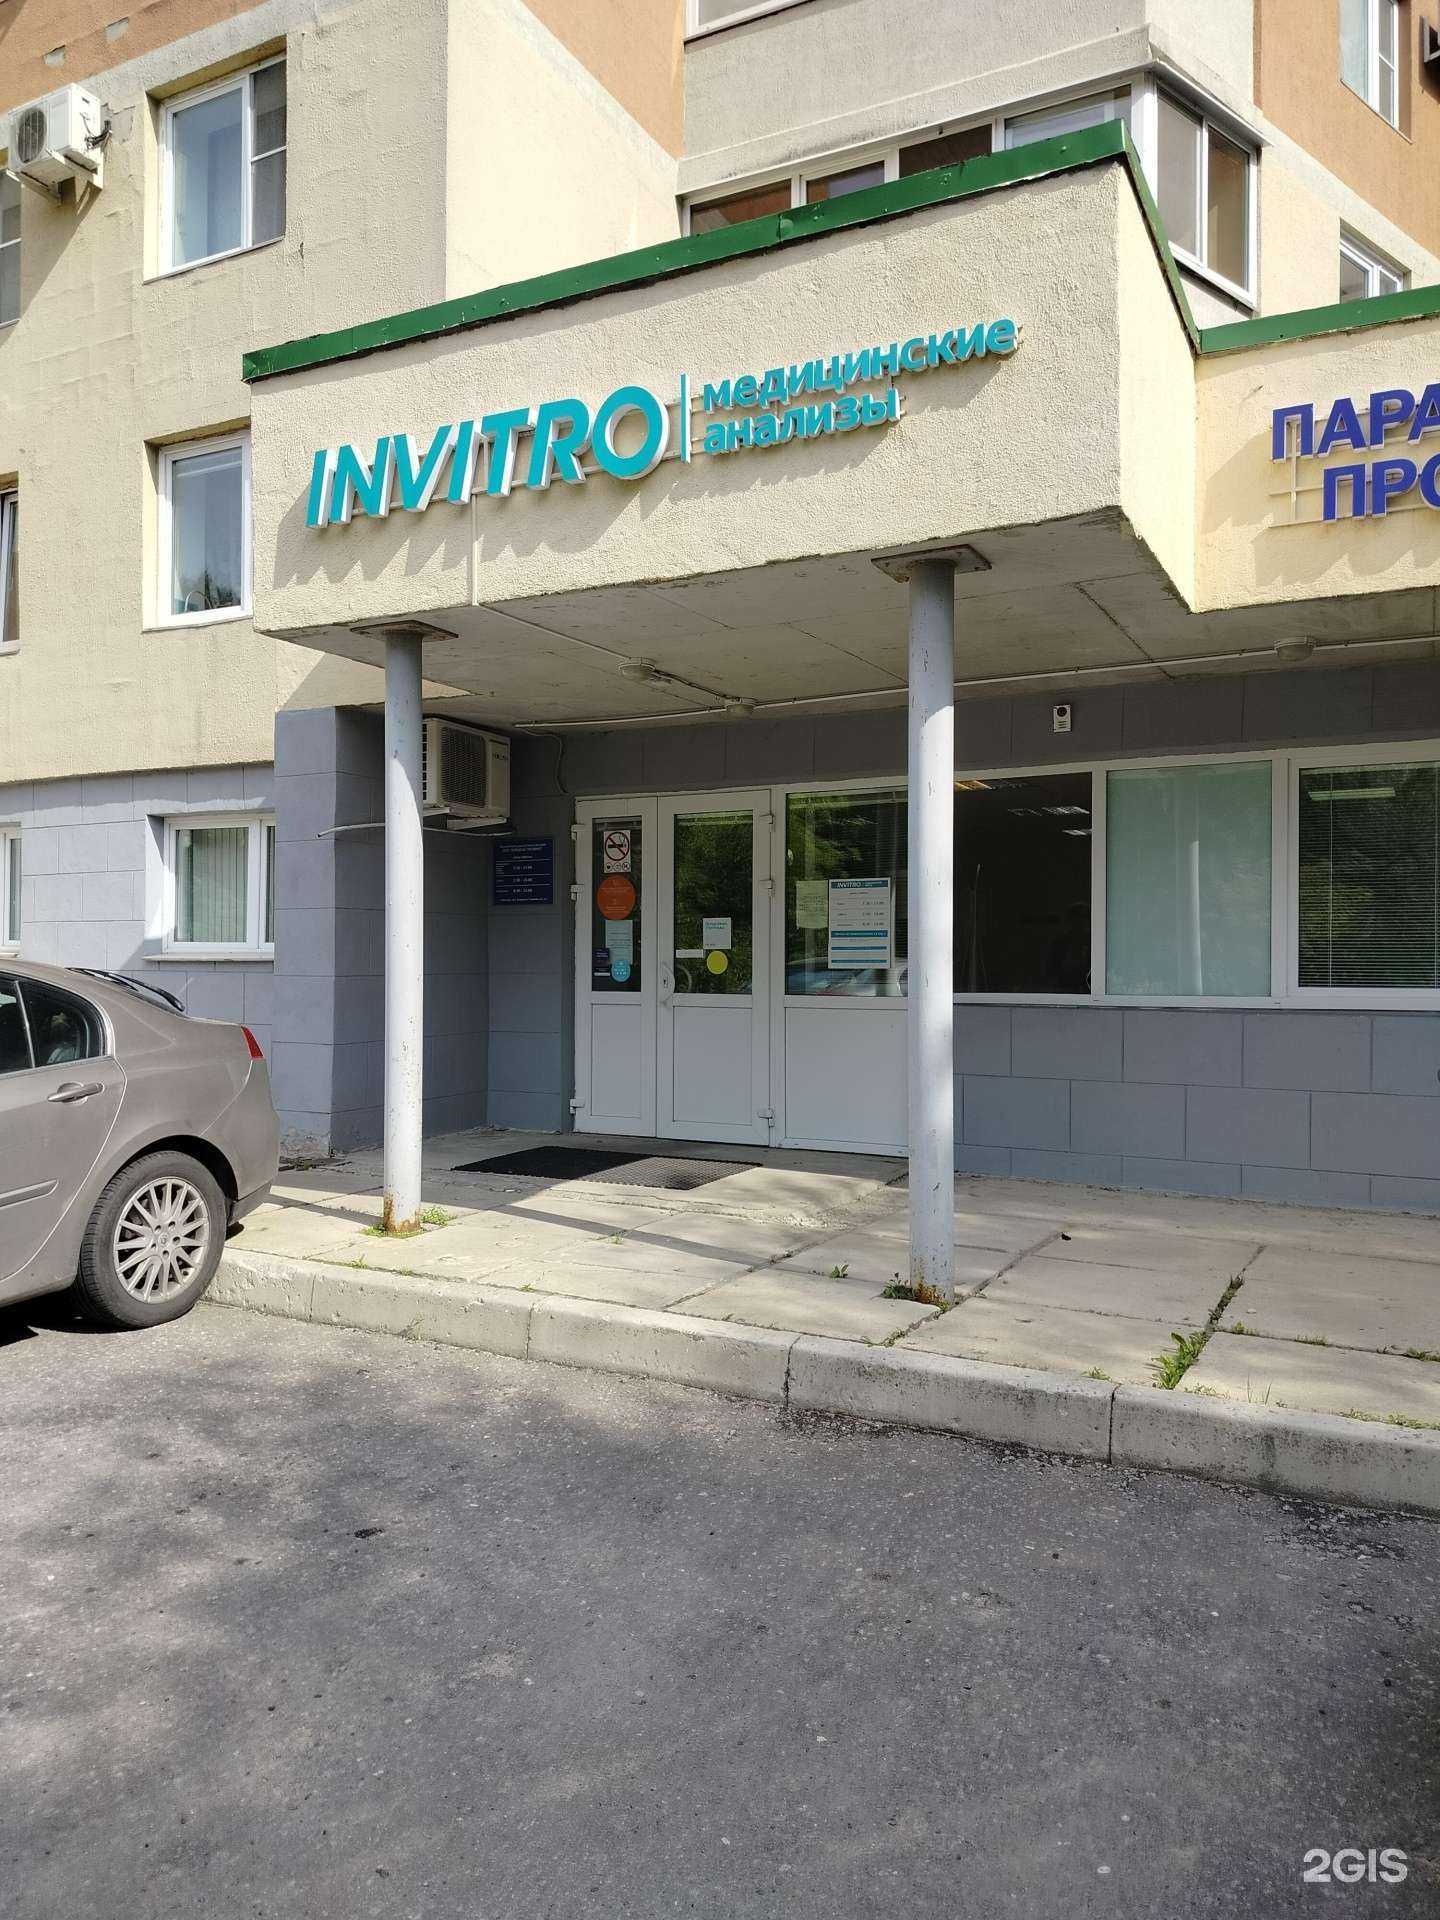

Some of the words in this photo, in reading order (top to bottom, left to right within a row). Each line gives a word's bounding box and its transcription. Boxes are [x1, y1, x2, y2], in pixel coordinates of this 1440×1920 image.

[703, 319, 1017, 413] медицинские
[306, 386, 668, 528] INVITRO
[703, 390, 901, 454] анализы
